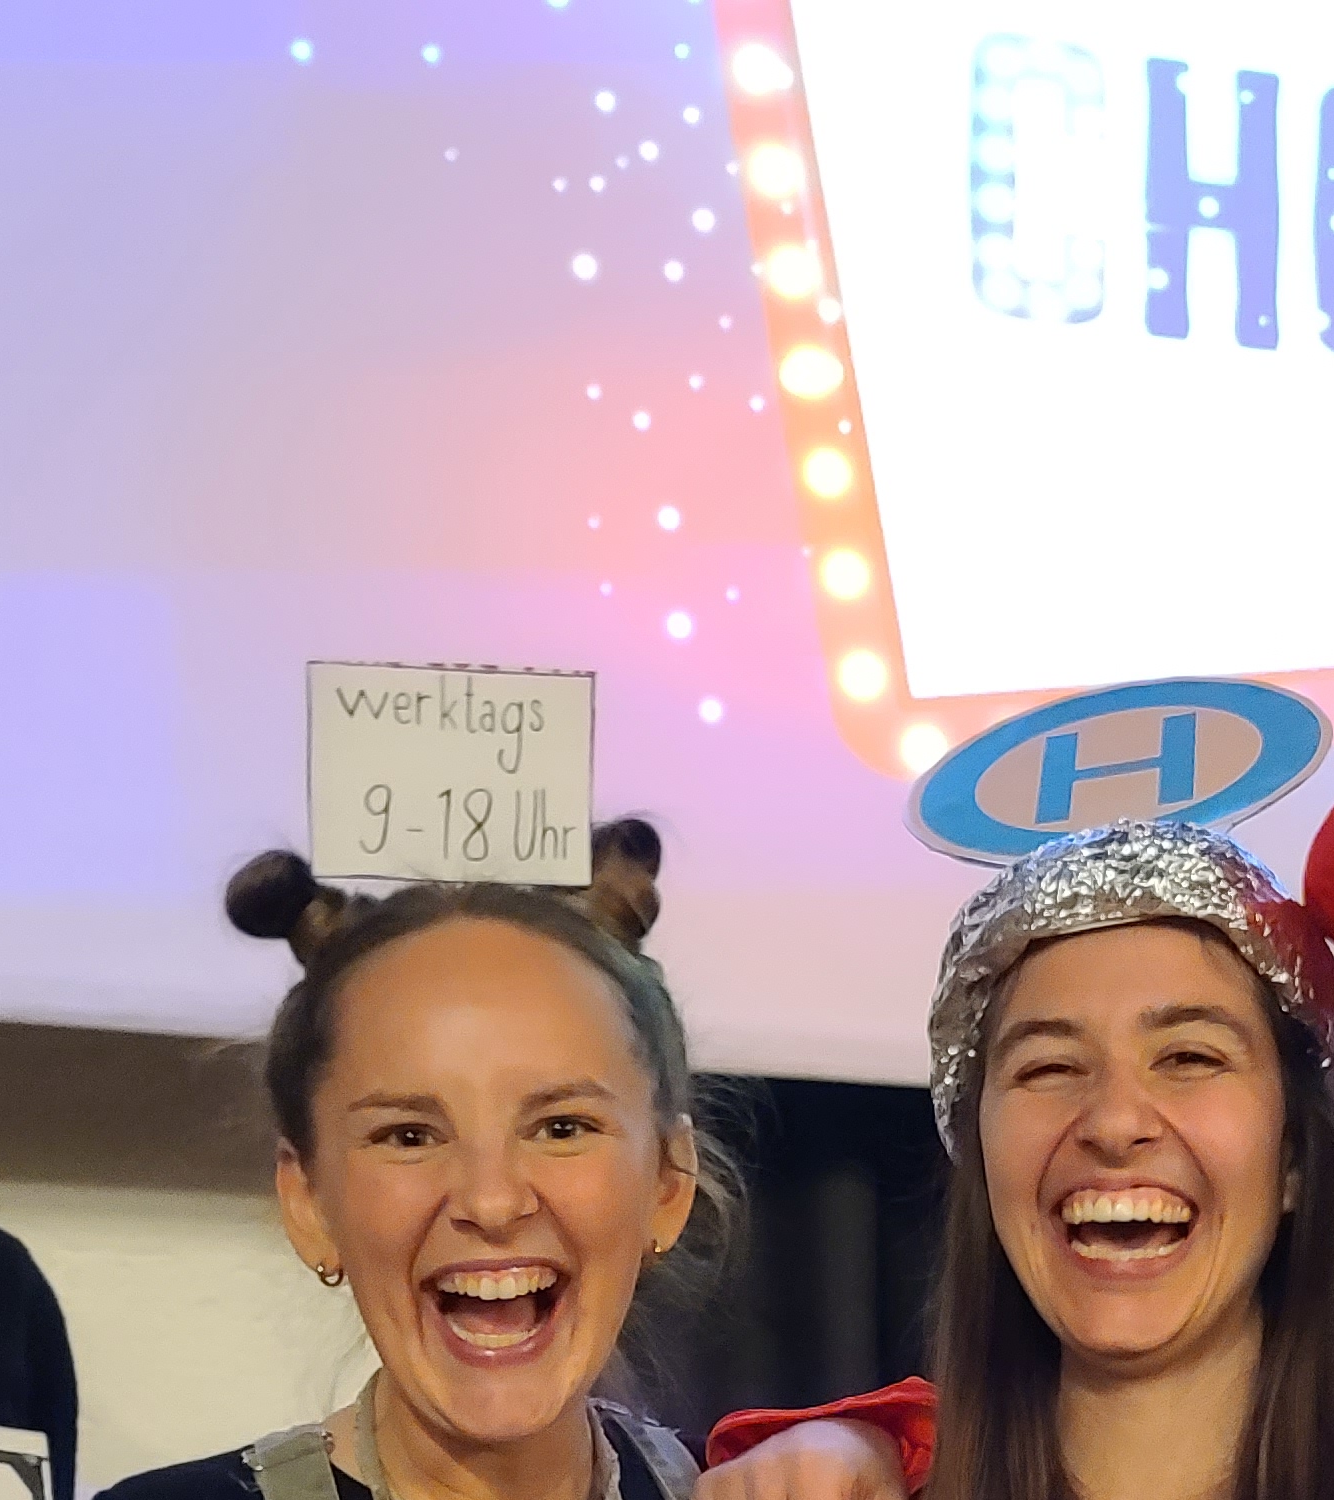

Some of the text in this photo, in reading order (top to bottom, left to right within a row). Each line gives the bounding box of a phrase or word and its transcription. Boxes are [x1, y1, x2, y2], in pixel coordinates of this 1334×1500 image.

[335, 675, 545, 774] werktags
[1035, 713, 1196, 824] H
[513, 788, 577, 861] Uhr
